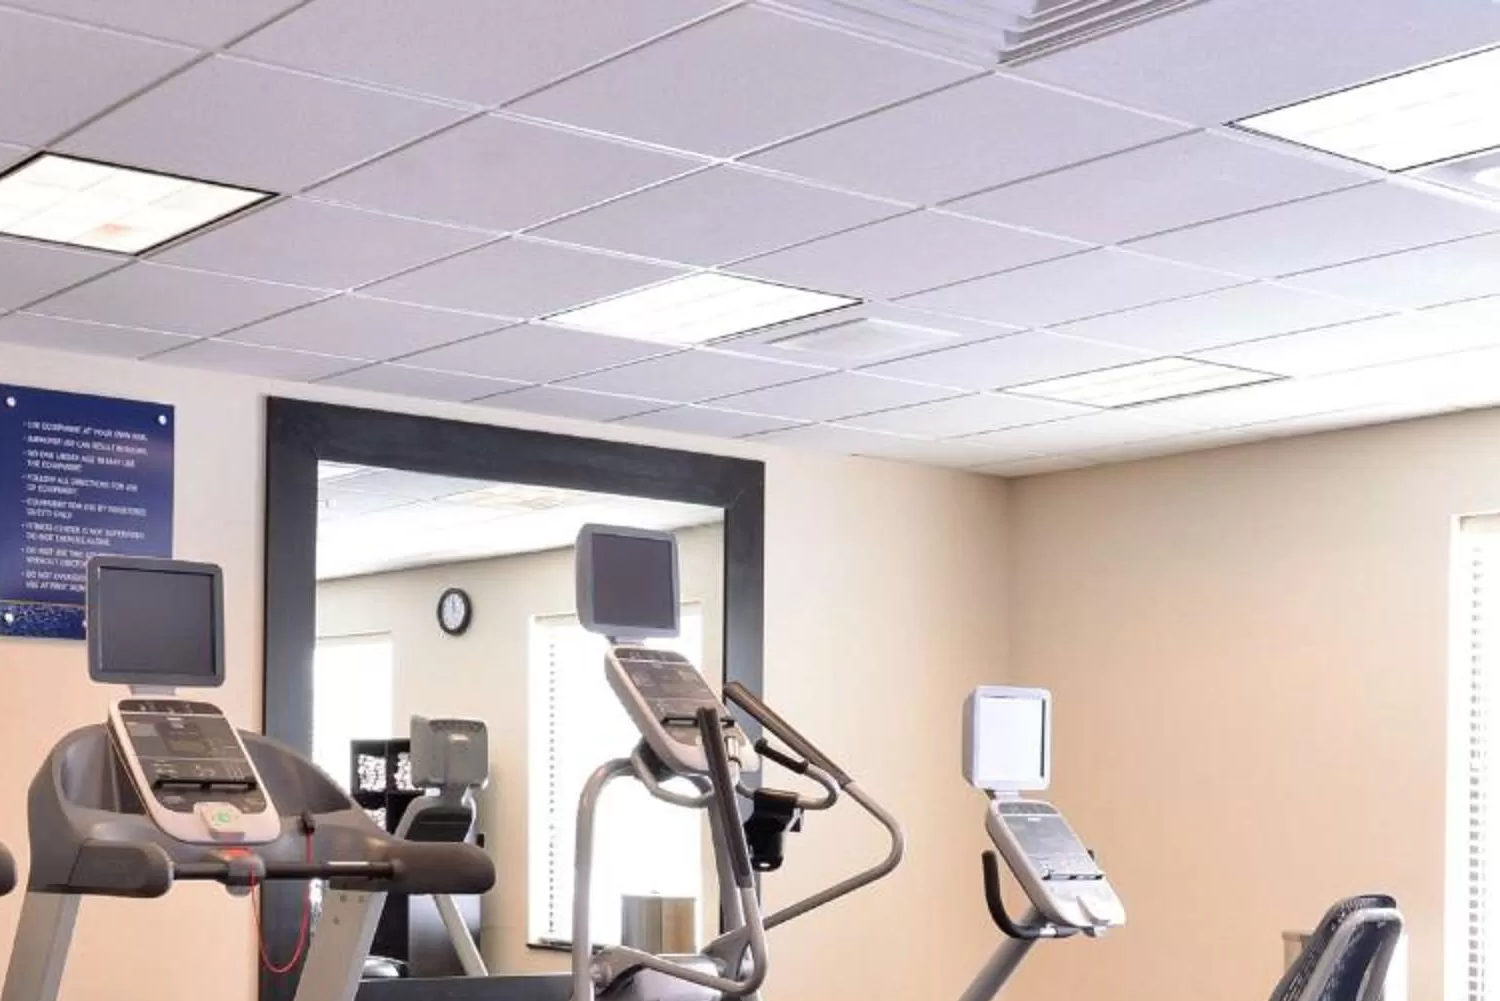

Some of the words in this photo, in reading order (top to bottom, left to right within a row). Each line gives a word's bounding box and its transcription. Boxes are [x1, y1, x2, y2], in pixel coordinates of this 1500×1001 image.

[41, 422, 81, 434] EQUIPMENT
[93, 428, 112, 437] YOUR
[114, 430, 130, 439] OWN
